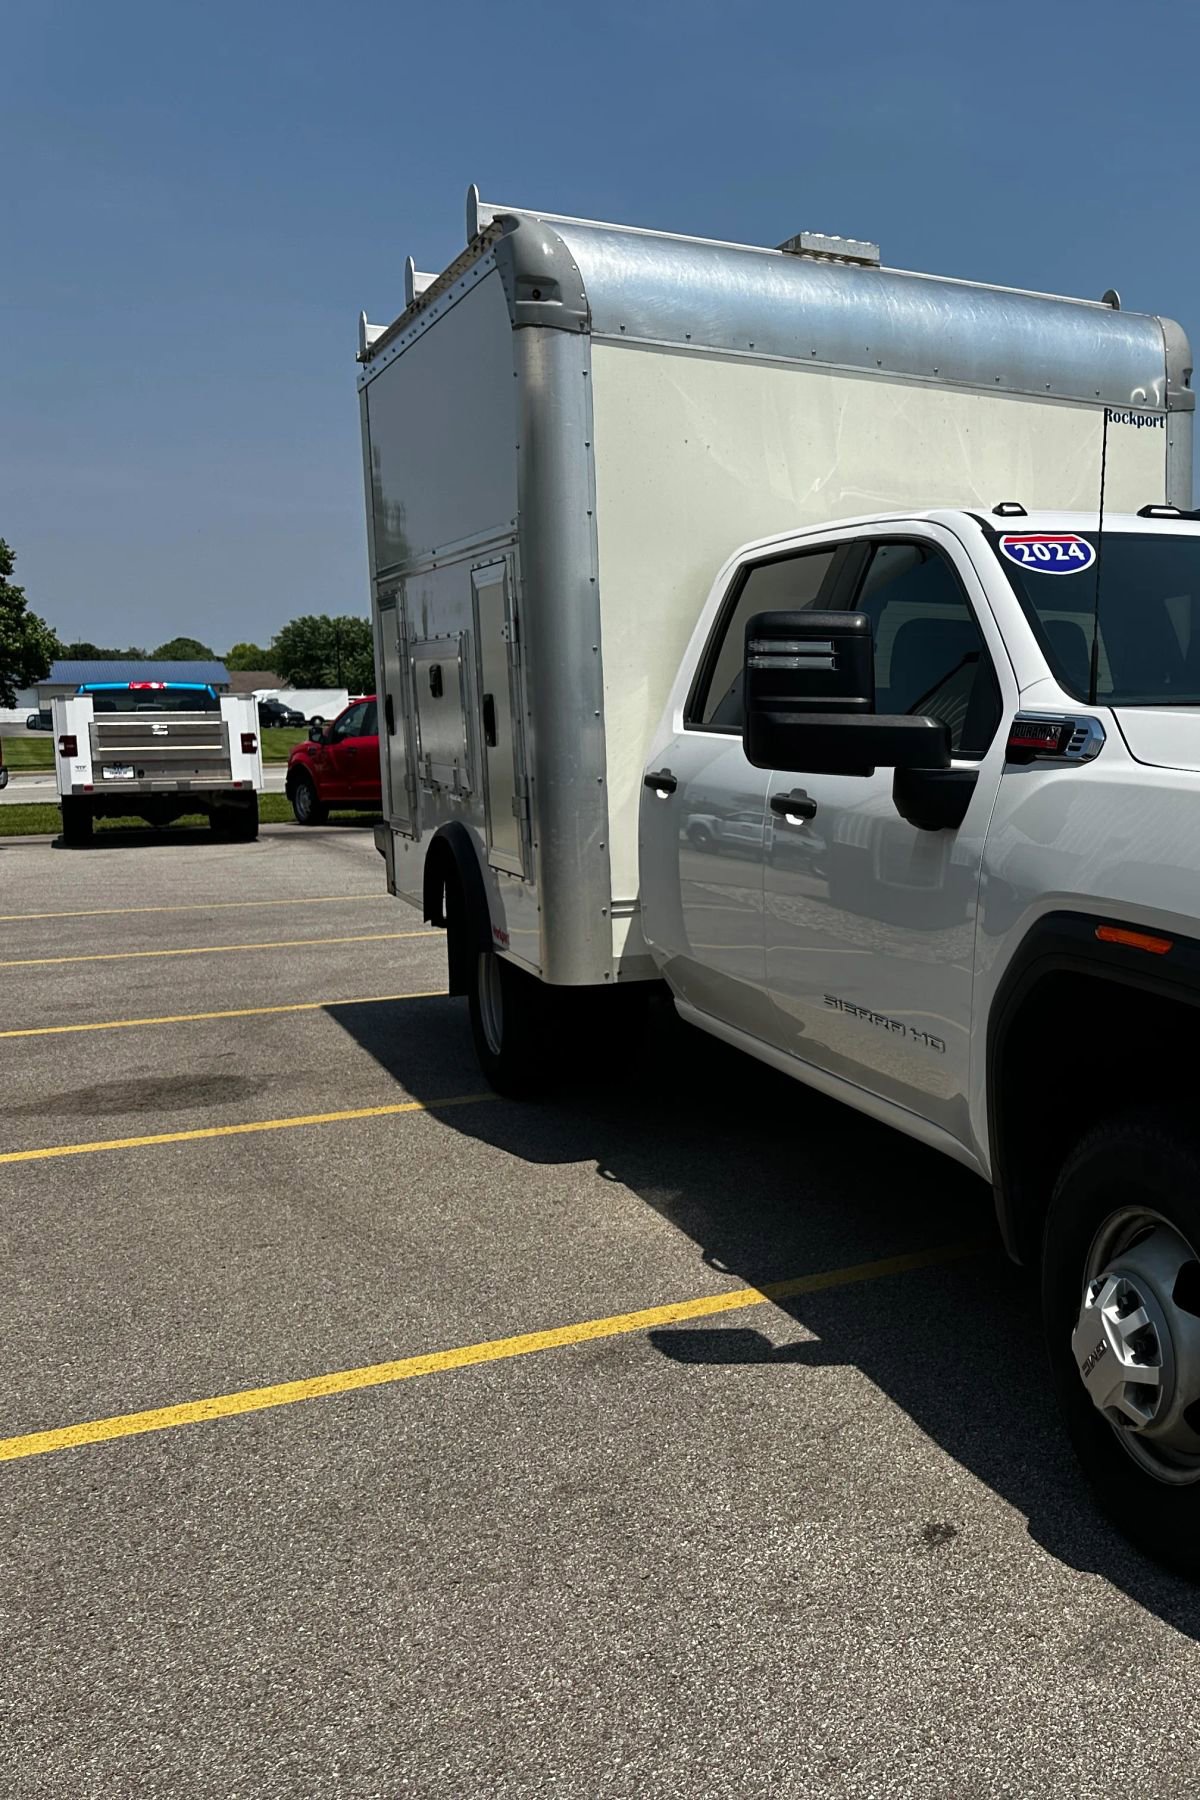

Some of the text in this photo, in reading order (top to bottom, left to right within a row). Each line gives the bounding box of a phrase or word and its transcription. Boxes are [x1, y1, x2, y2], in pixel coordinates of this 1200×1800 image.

[1106, 408, 1165, 429] Rockport
[1014, 543, 1085, 562] 2024
[823, 994, 946, 1053] SIERRA HD
